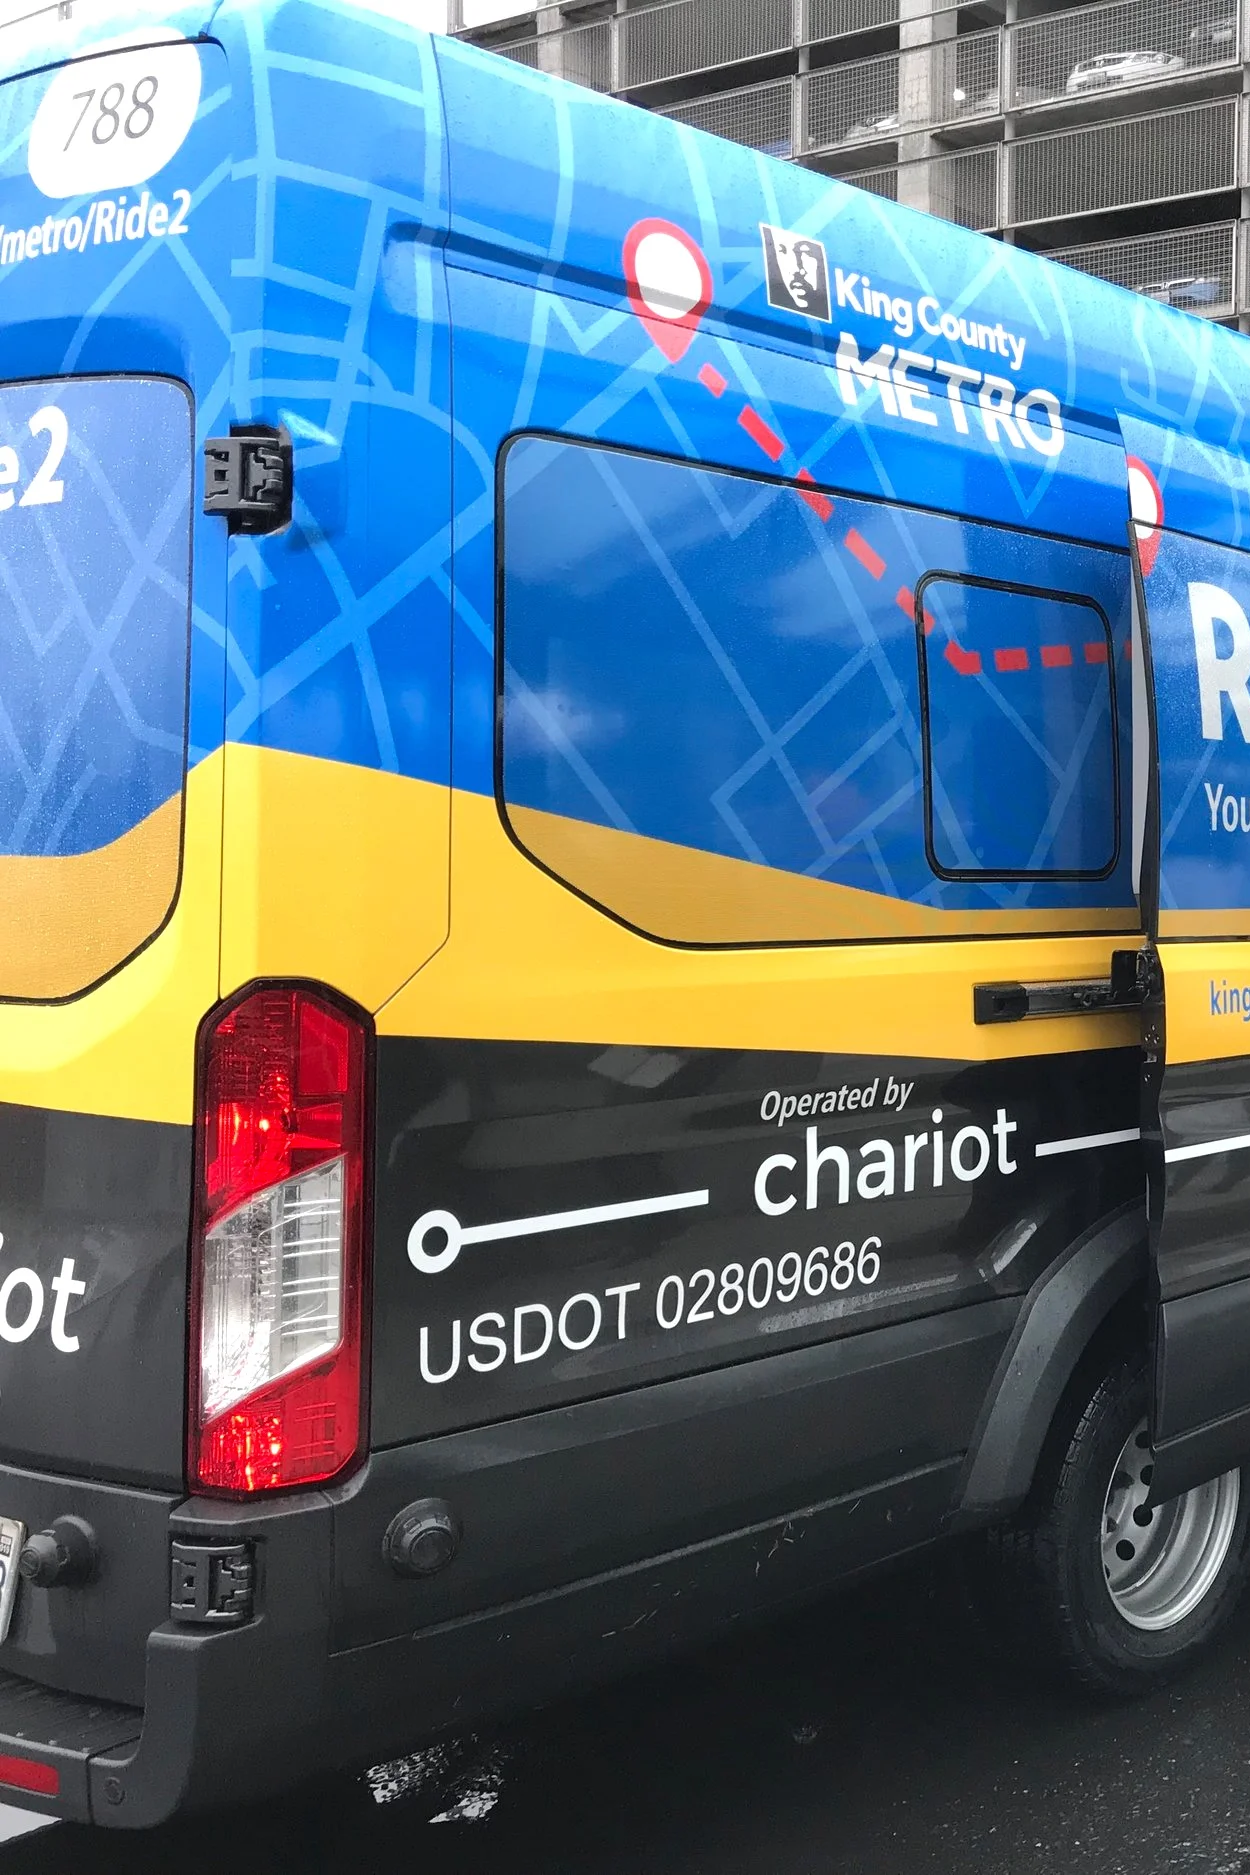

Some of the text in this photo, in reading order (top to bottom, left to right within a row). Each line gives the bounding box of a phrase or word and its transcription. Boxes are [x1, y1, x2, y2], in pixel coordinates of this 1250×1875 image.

[63, 75, 159, 153] 788
[833, 268, 1026, 370] King County
[835, 331, 1065, 457] METRO
[760, 1075, 915, 1128] Operated by
[754, 1108, 1018, 1216] chariot
[0, 1232, 86, 1353] ot
[419, 1235, 883, 1385] USDOT 02809686
